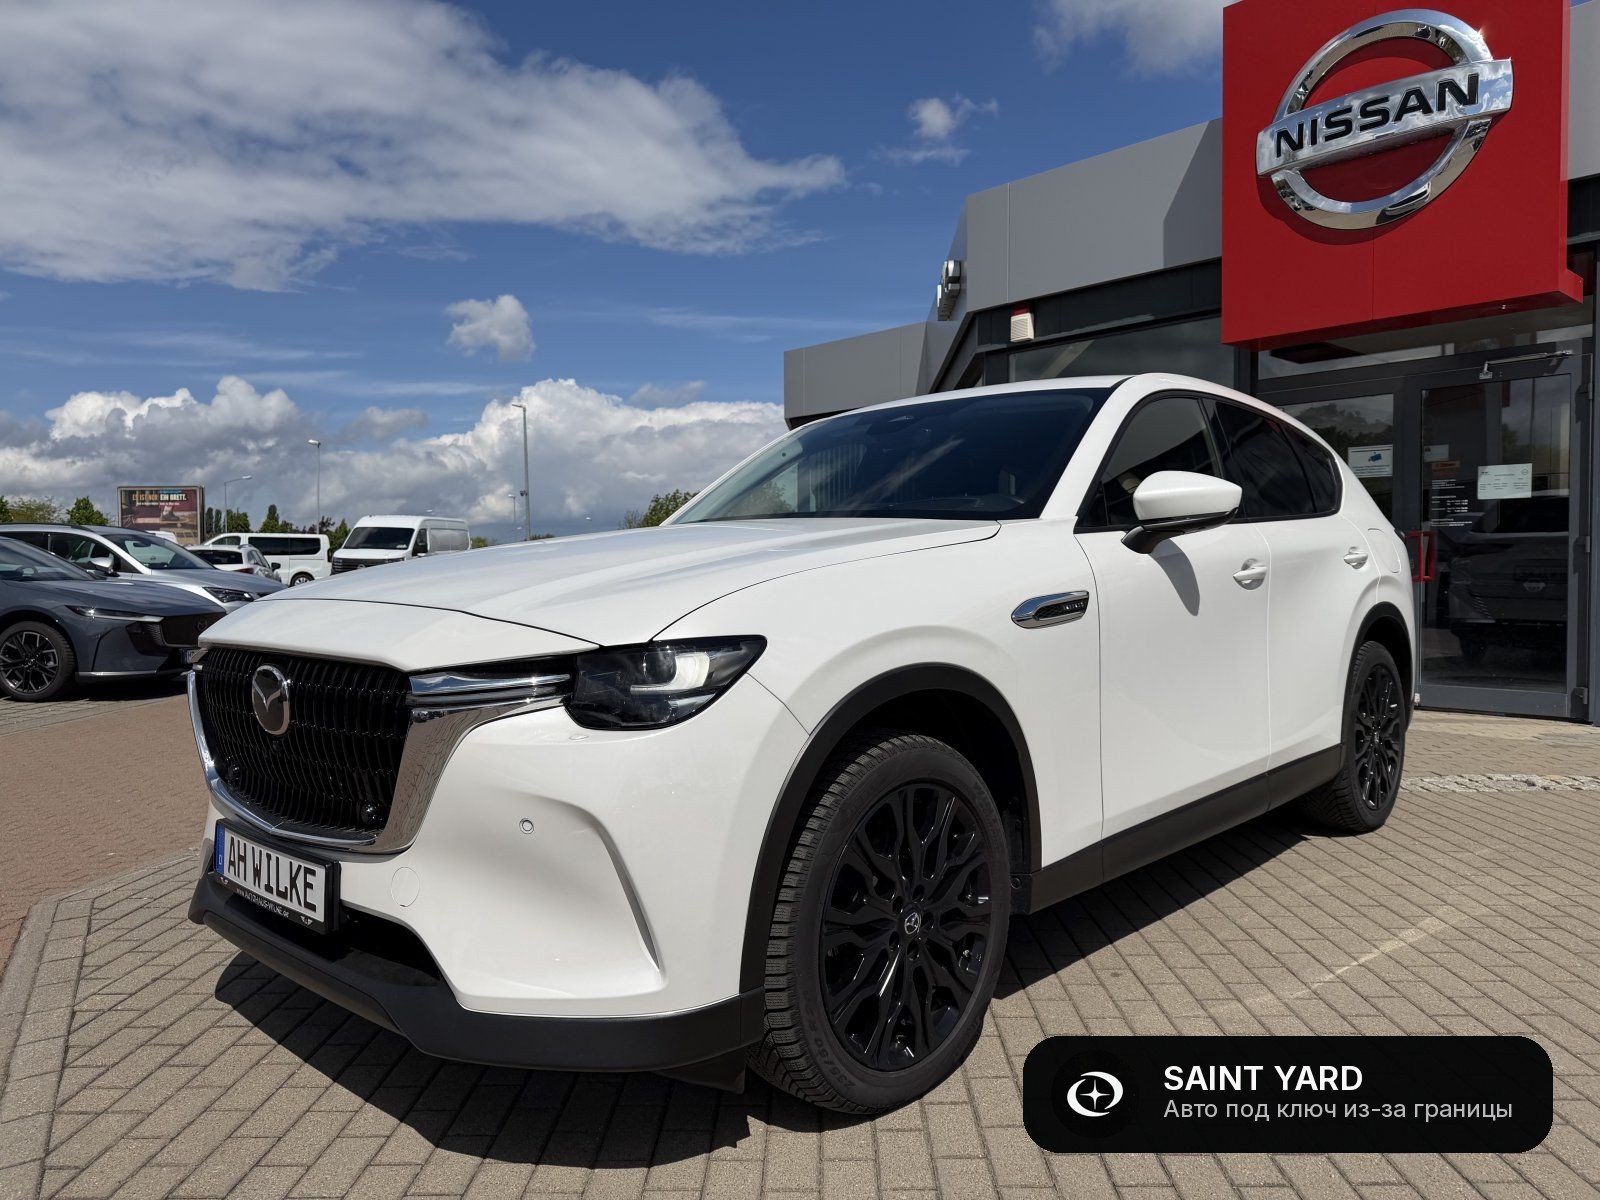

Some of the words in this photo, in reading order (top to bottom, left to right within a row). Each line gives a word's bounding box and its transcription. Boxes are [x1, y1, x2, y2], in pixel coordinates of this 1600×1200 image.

[1276, 73, 1479, 158] NISSAN
[228, 836, 247, 882] AH
[252, 846, 317, 913] WILKE
